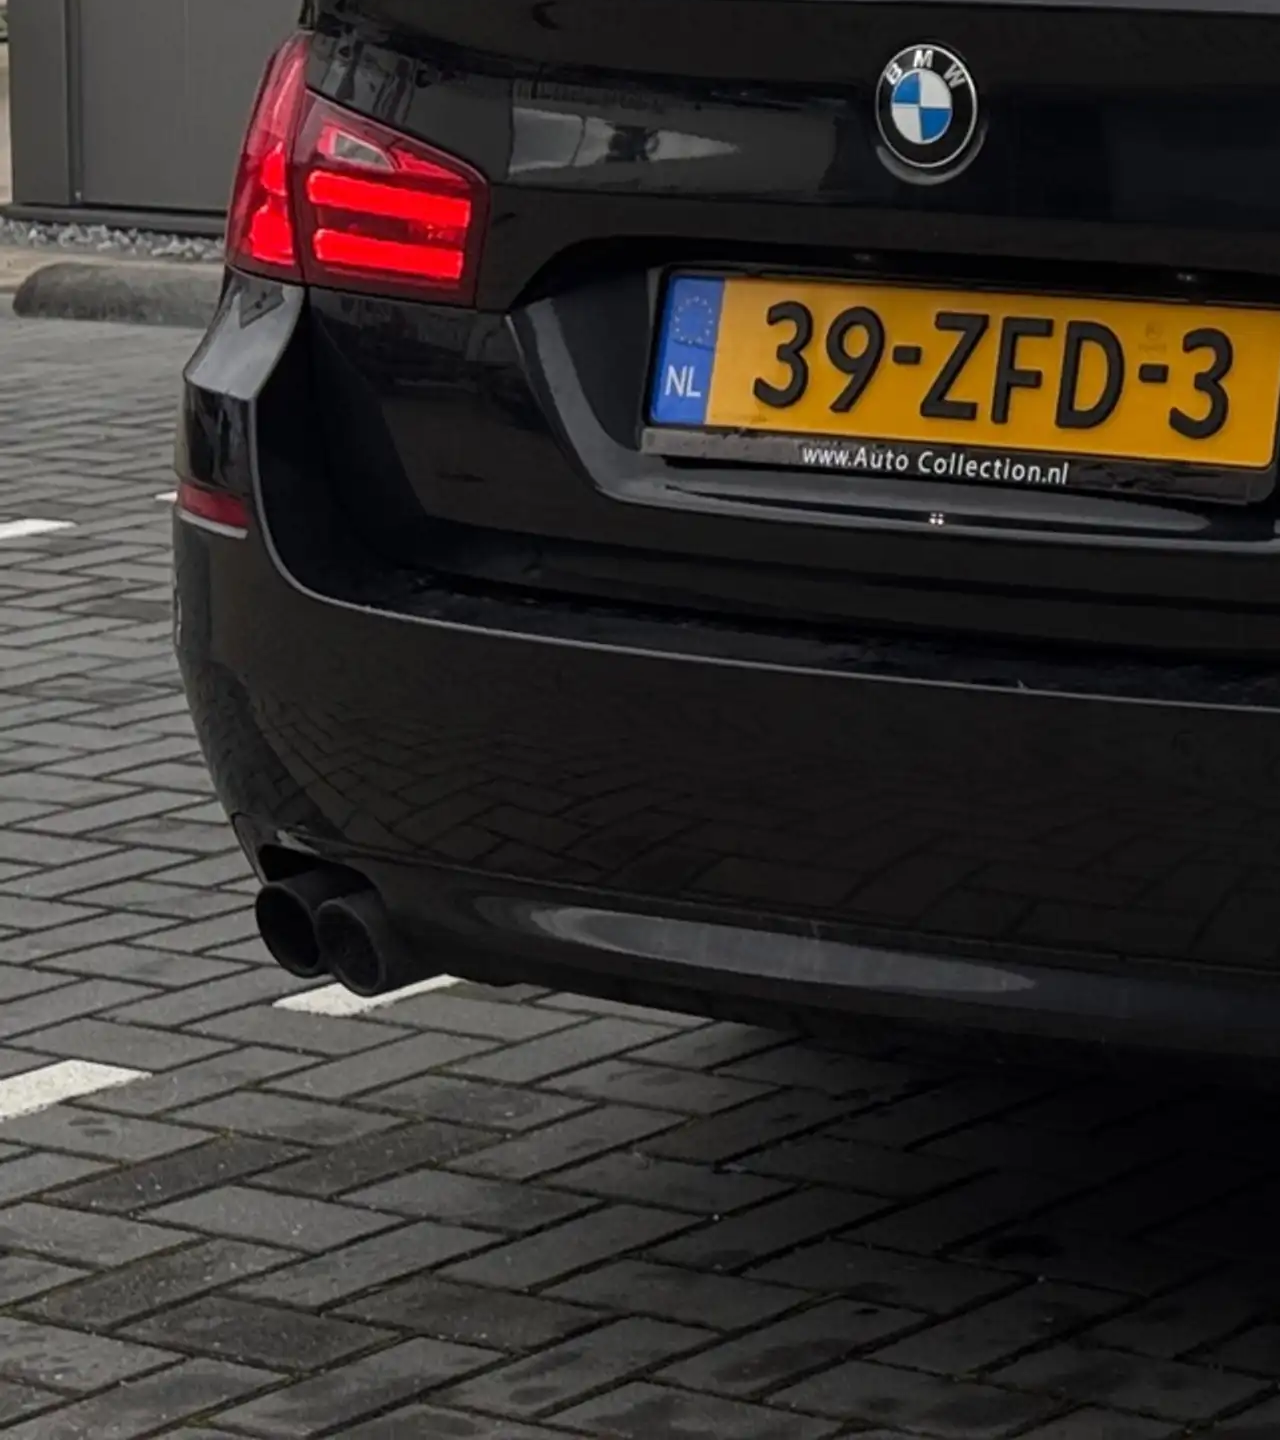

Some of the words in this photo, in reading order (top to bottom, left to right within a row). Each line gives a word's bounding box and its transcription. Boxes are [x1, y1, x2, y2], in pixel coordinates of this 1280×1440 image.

[885, 49, 966, 89] BMW
[664, 364, 702, 397] NL
[753, 300, 1233, 438] 39-ZFD-3
[802, 446, 909, 472] www.Auto
[918, 450, 1069, 485] Collection.nl
